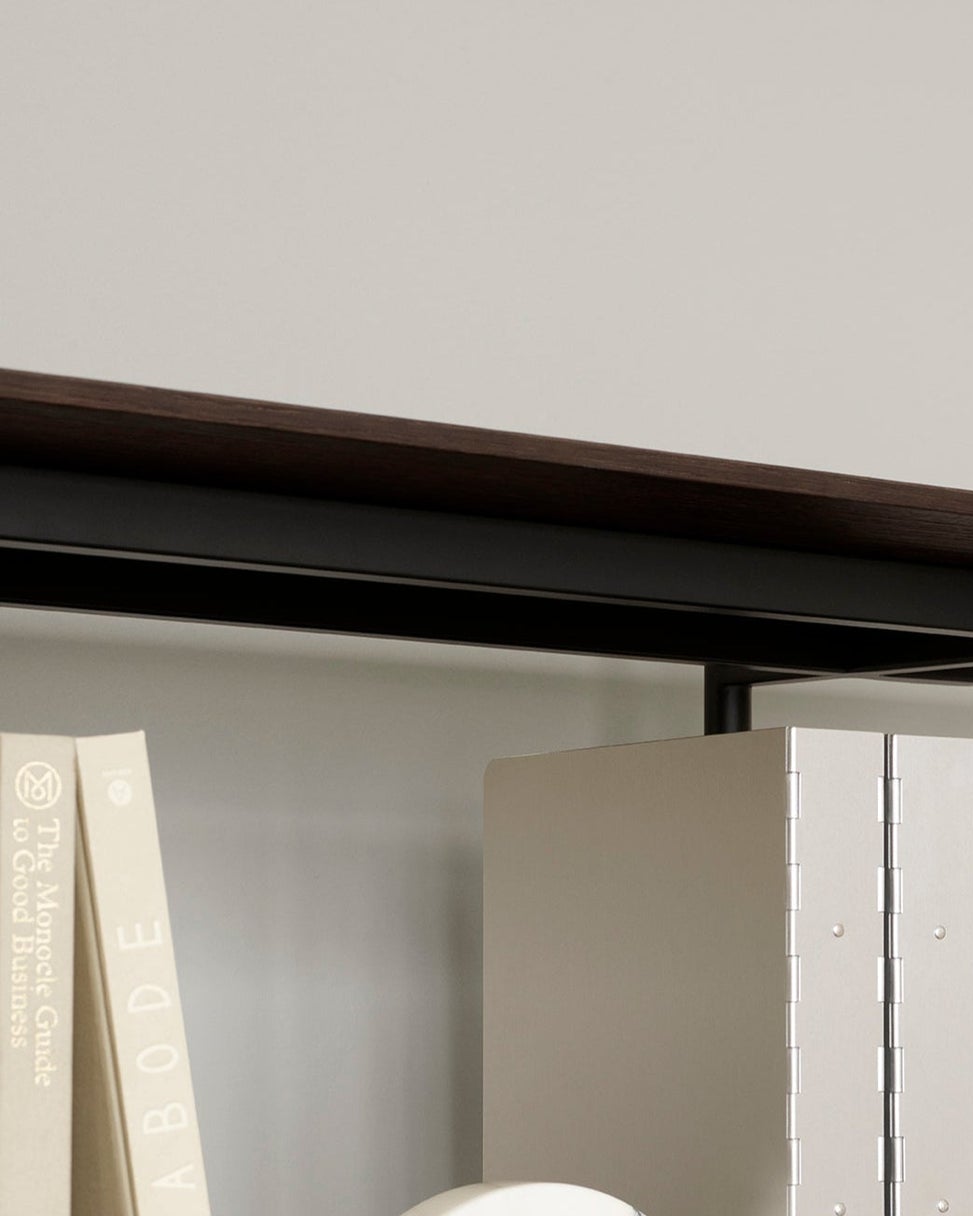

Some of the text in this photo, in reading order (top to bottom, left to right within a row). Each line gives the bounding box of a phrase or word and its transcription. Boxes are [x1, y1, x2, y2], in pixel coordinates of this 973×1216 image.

[10, 818, 35, 1049] to Good Business
[34, 818, 61, 1087] The Monocle Guide
[116, 919, 196, 1190] ABODE
